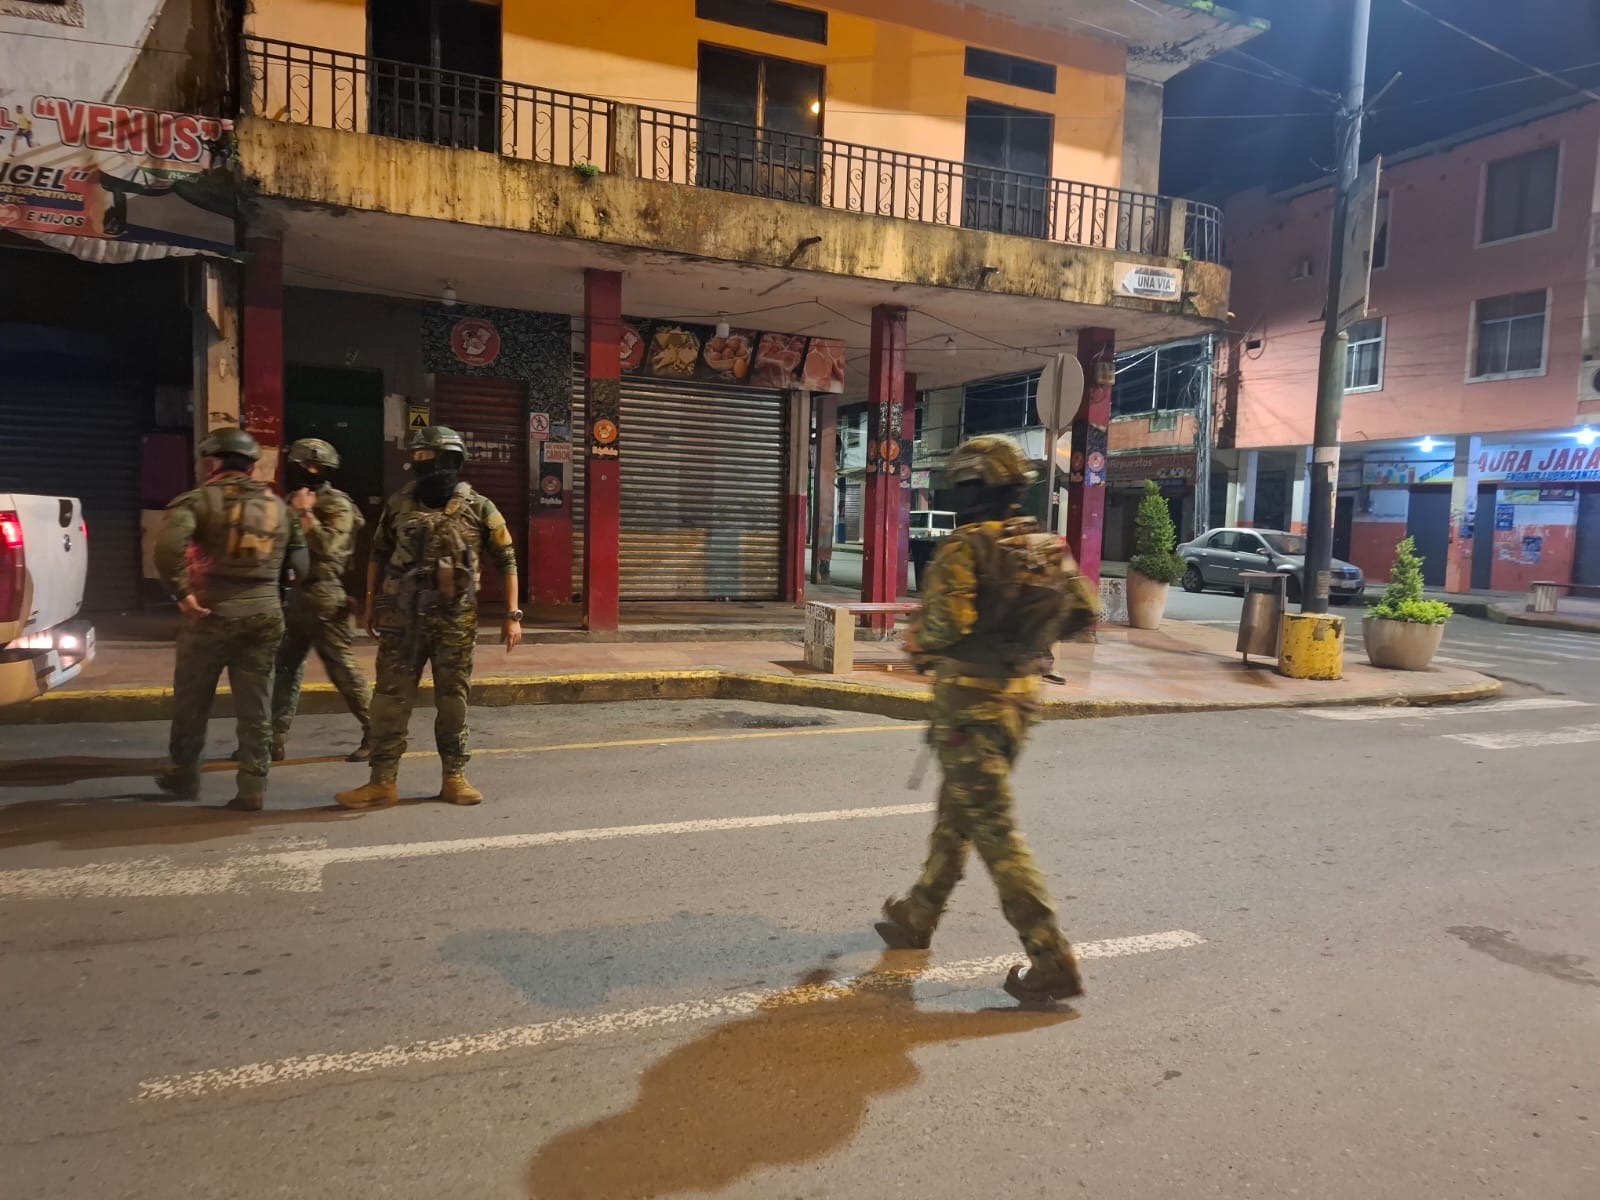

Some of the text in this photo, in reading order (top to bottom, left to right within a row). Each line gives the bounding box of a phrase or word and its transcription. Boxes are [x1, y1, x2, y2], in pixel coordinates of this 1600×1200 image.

[27, 211, 84, 226] E HIJOS
[1137, 275, 1171, 290] UNA VIA
